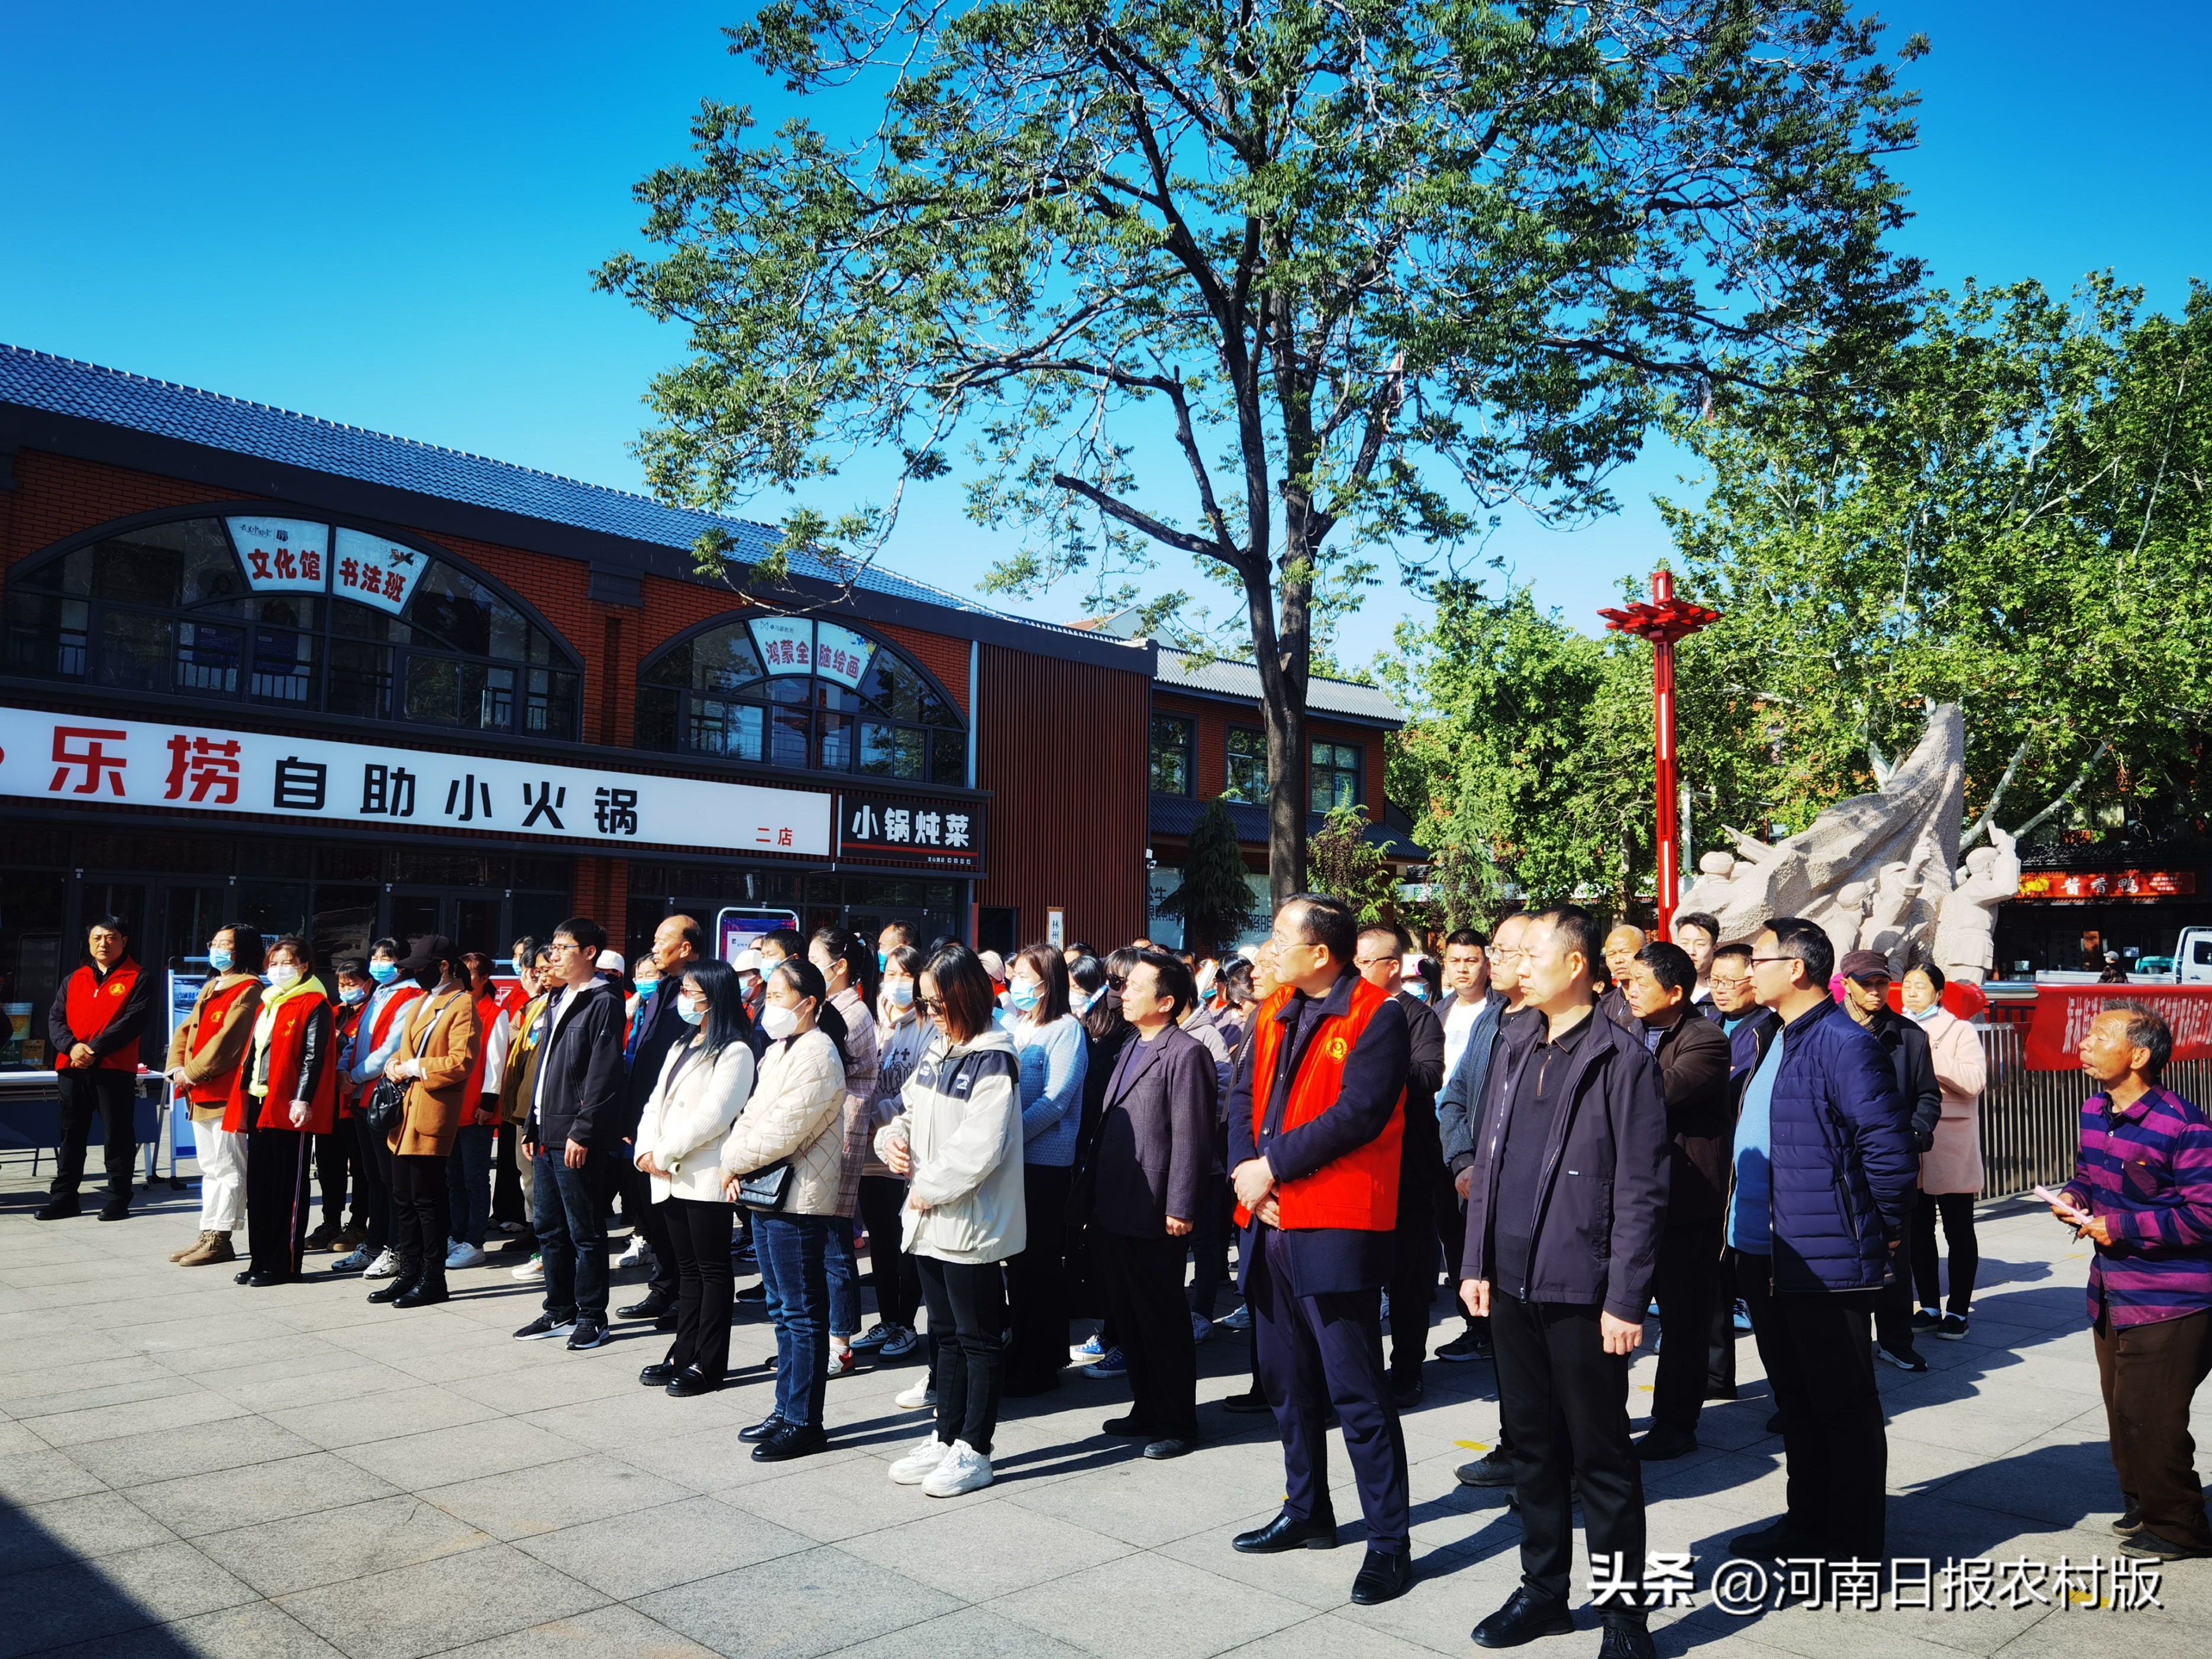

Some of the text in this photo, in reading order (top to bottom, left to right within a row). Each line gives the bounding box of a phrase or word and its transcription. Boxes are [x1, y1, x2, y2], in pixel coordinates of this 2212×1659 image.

[247, 548, 321, 582] 文化馆
[338, 557, 407, 603] 书法班
[765, 639, 809, 667] 鸿蒙全
[818, 643, 861, 680] 脑绘画
[49, 725, 638, 835] 乐捞 自助小火锅
[755, 827, 793, 847] 二店
[851, 804, 970, 848] 小锅炖菜
